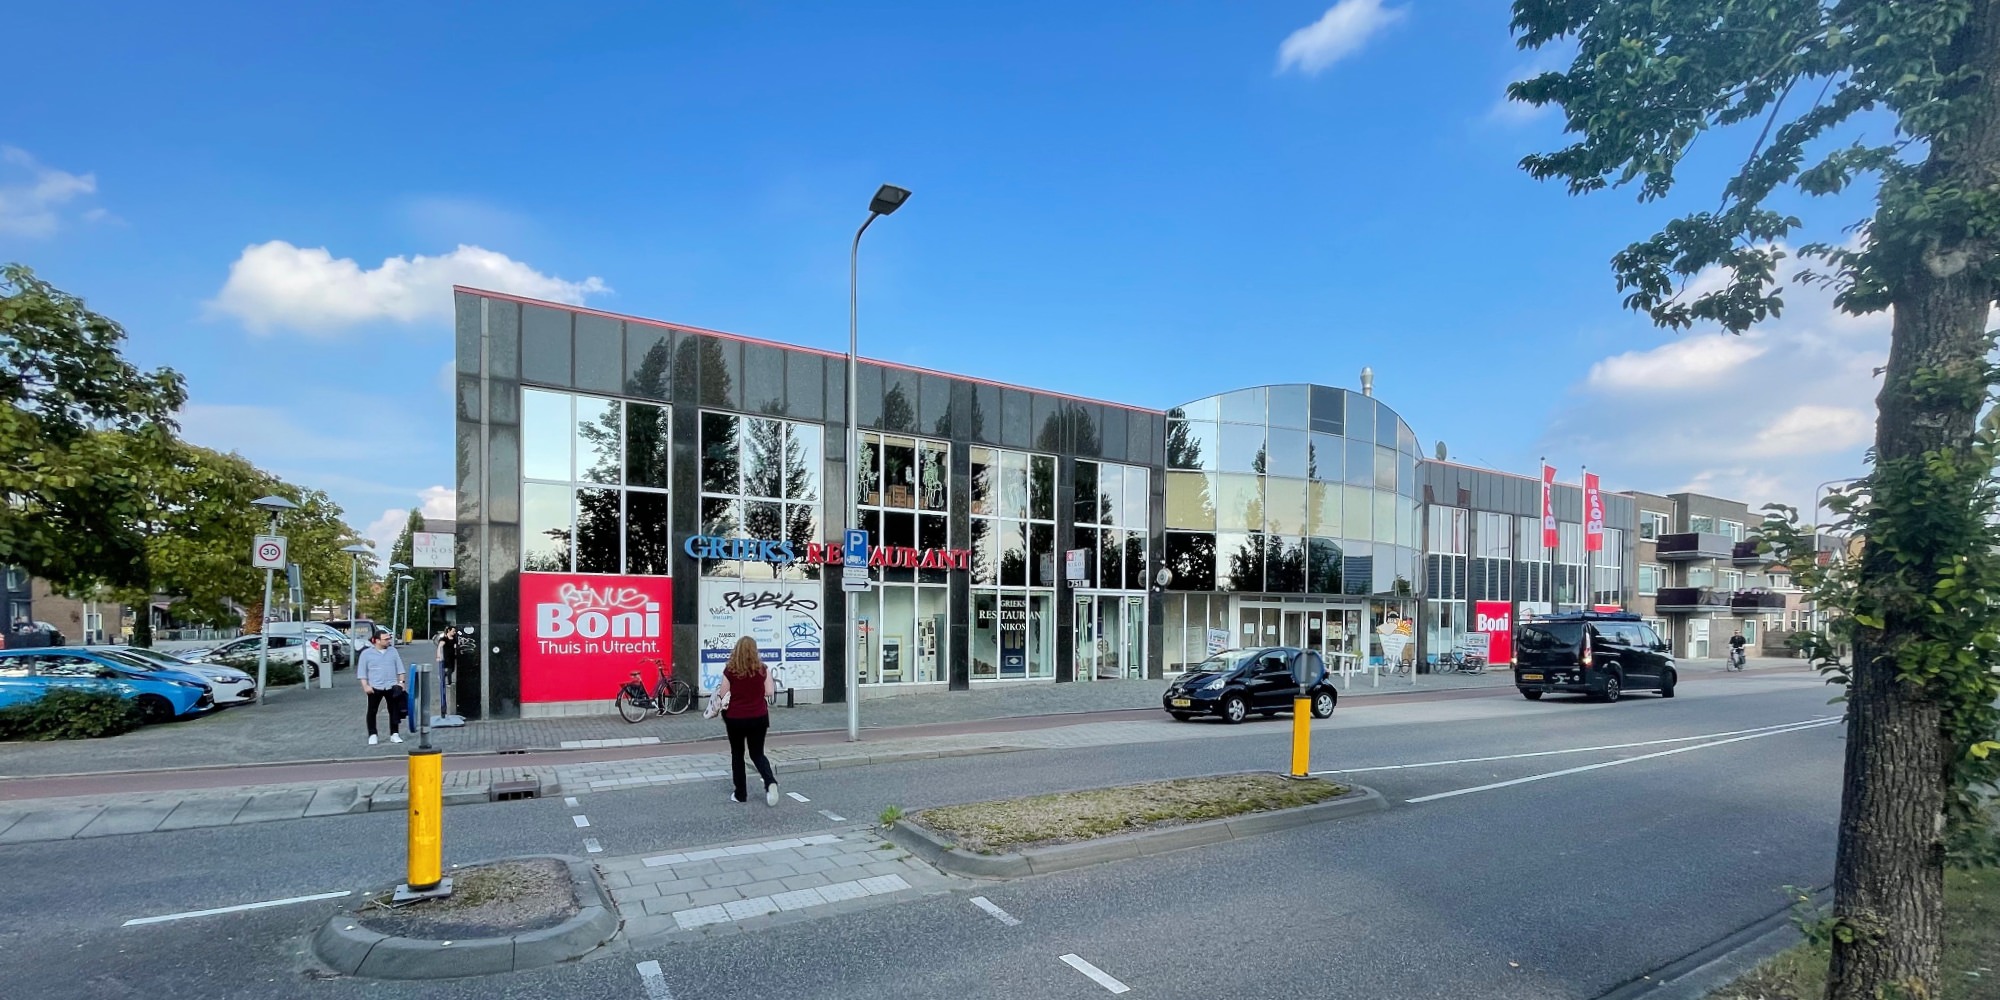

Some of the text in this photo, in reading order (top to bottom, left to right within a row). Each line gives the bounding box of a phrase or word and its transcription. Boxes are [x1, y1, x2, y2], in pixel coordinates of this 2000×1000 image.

[1587, 488, 1603, 534] Boni
[415, 546, 453, 554] NIKOS
[850, 532, 864, 552] P
[262, 548, 277, 556] 30
[684, 535, 970, 569] GRIEKS REAURANT
[1001, 599, 1026, 608] GRIEKS
[537, 602, 660, 639] Boni
[1001, 623, 1026, 631] NIKOS
[1477, 612, 1509, 632] Boni
[538, 640, 660, 654] Thuis in Utrecht.
